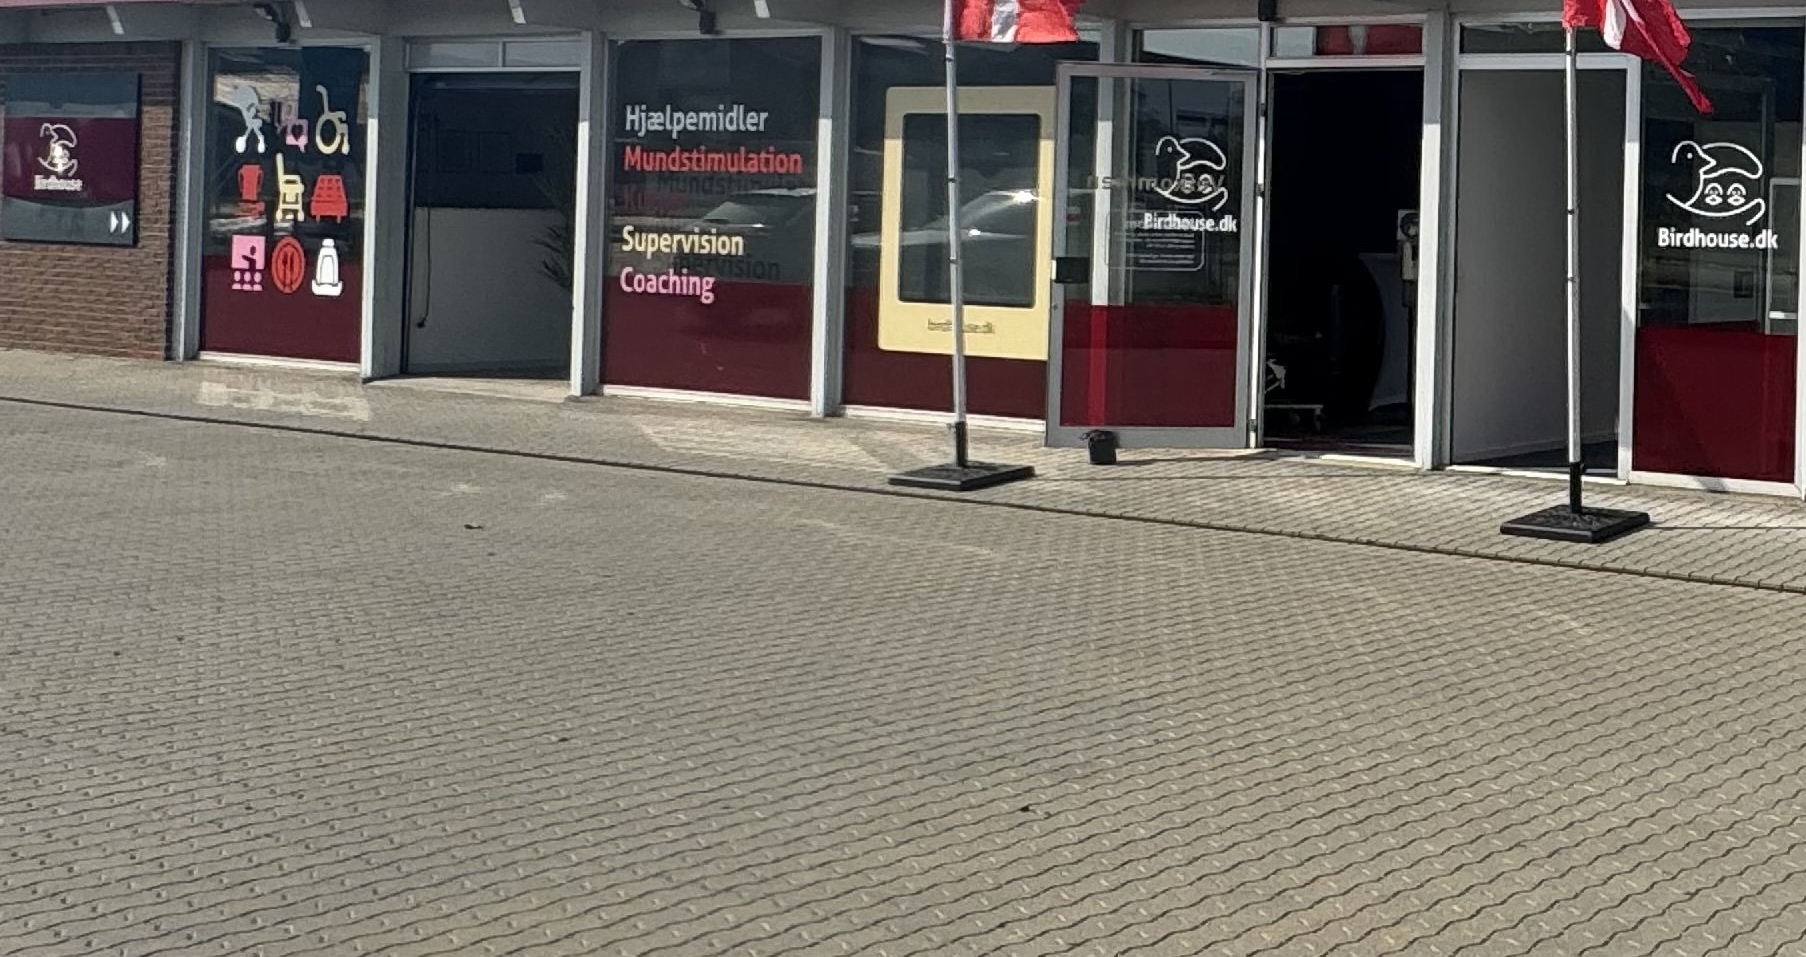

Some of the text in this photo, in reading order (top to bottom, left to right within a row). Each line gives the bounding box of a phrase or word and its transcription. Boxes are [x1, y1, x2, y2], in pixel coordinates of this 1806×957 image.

[625, 105, 768, 139] Hjælpemidler
[624, 145, 803, 173] Mundstimulation
[622, 225, 744, 259] Supervision
[1657, 227, 1778, 249] Birdhouse.dk
[620, 266, 715, 304] Coaching
